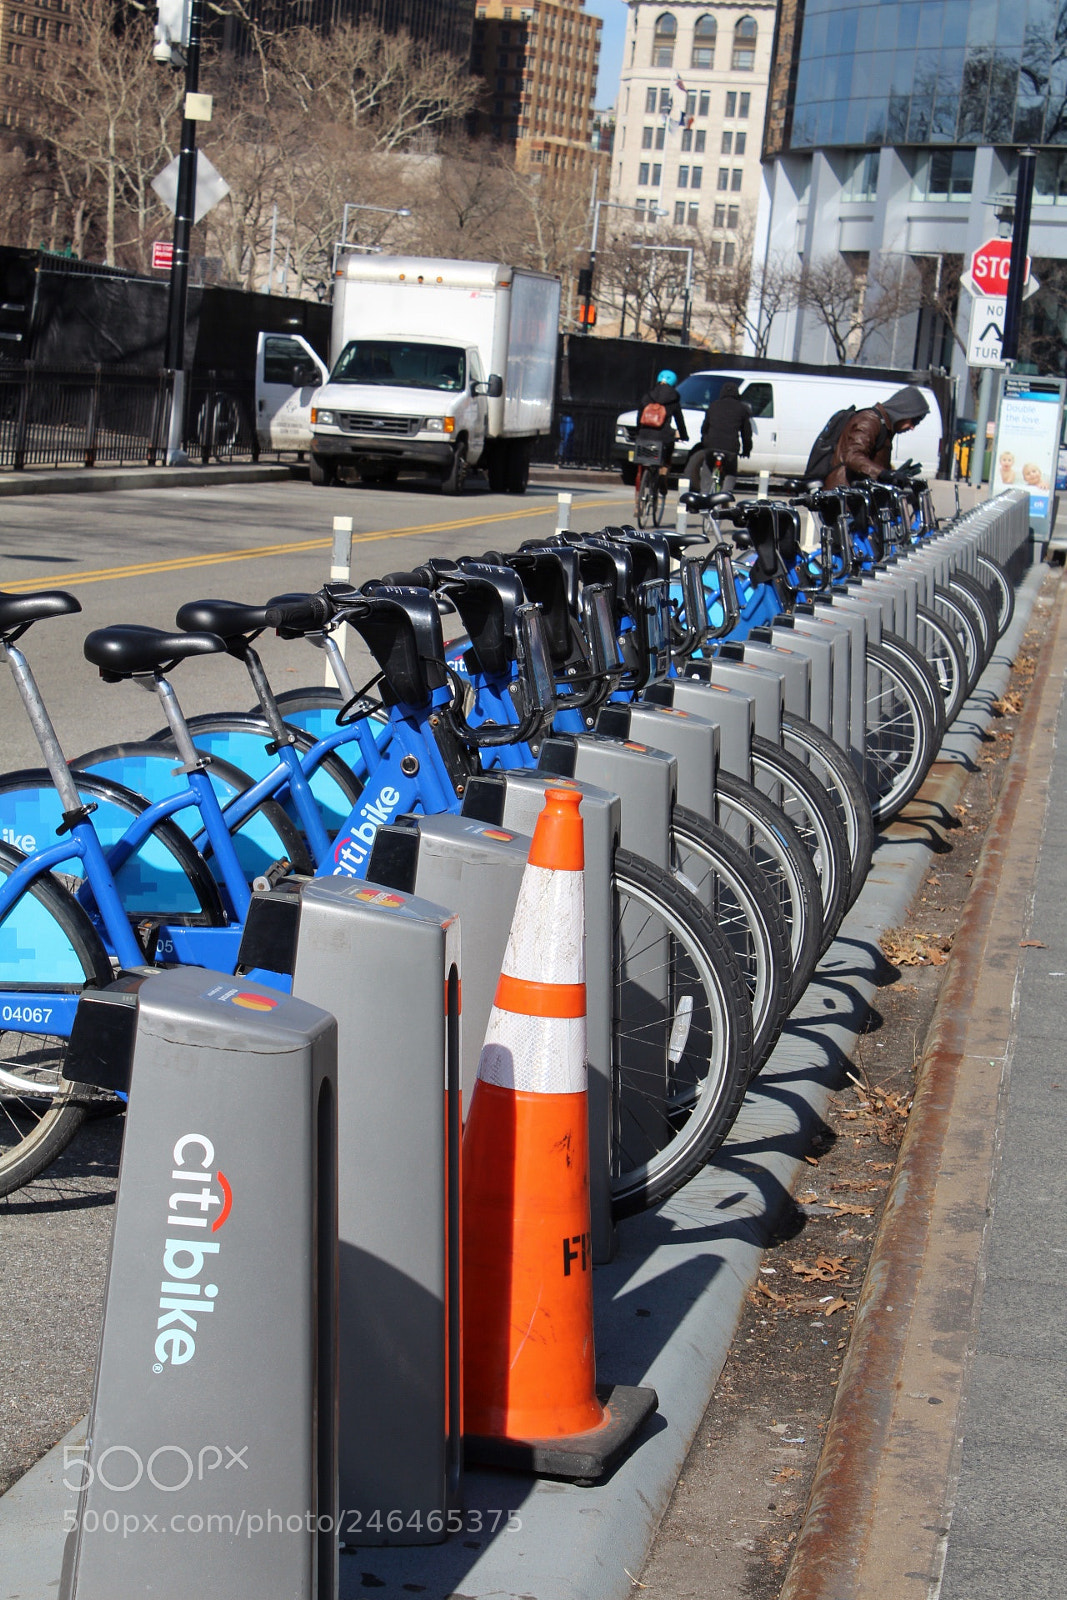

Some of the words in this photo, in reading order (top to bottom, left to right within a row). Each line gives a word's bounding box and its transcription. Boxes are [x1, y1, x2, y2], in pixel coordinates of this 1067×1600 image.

[975, 256, 1011, 280] STO
[986, 305, 1004, 316] NO
[975, 347, 999, 358] TUR
[350, 786, 400, 846] bike
[0, 828, 38, 851] ike
[2, 1006, 53, 1024] 04067
[168, 1133, 232, 1232] citi
[154, 1238, 221, 1366] bike
